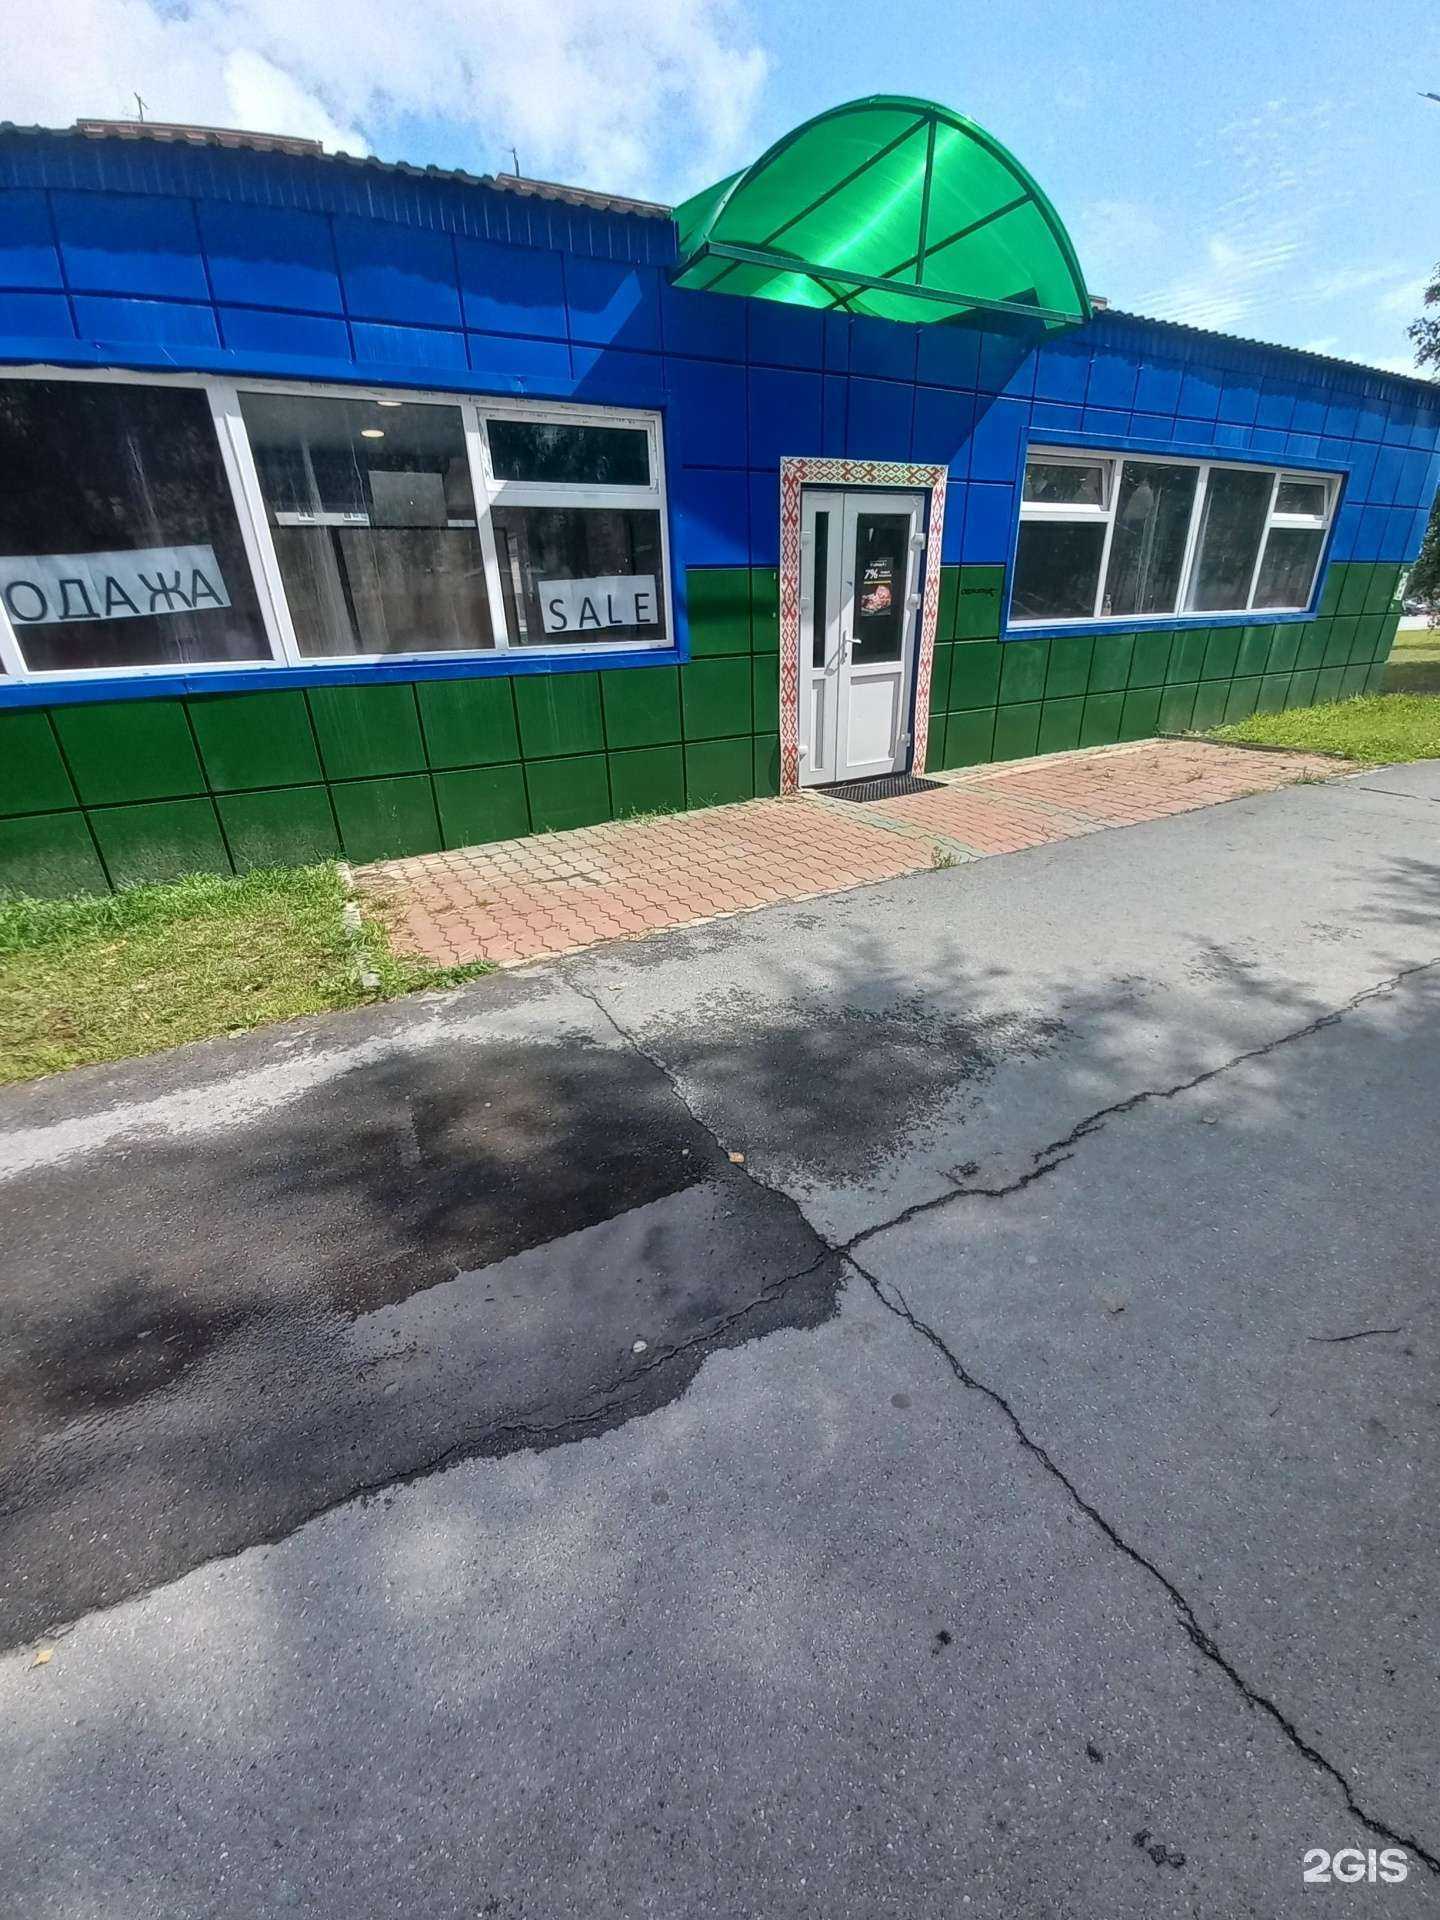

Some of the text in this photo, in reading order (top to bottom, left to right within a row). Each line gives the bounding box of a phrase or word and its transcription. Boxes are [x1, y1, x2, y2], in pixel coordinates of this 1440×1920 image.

[863, 568, 878, 580] 7%
[5, 568, 224, 622] ОДАЖА
[549, 593, 651, 630] SALE
